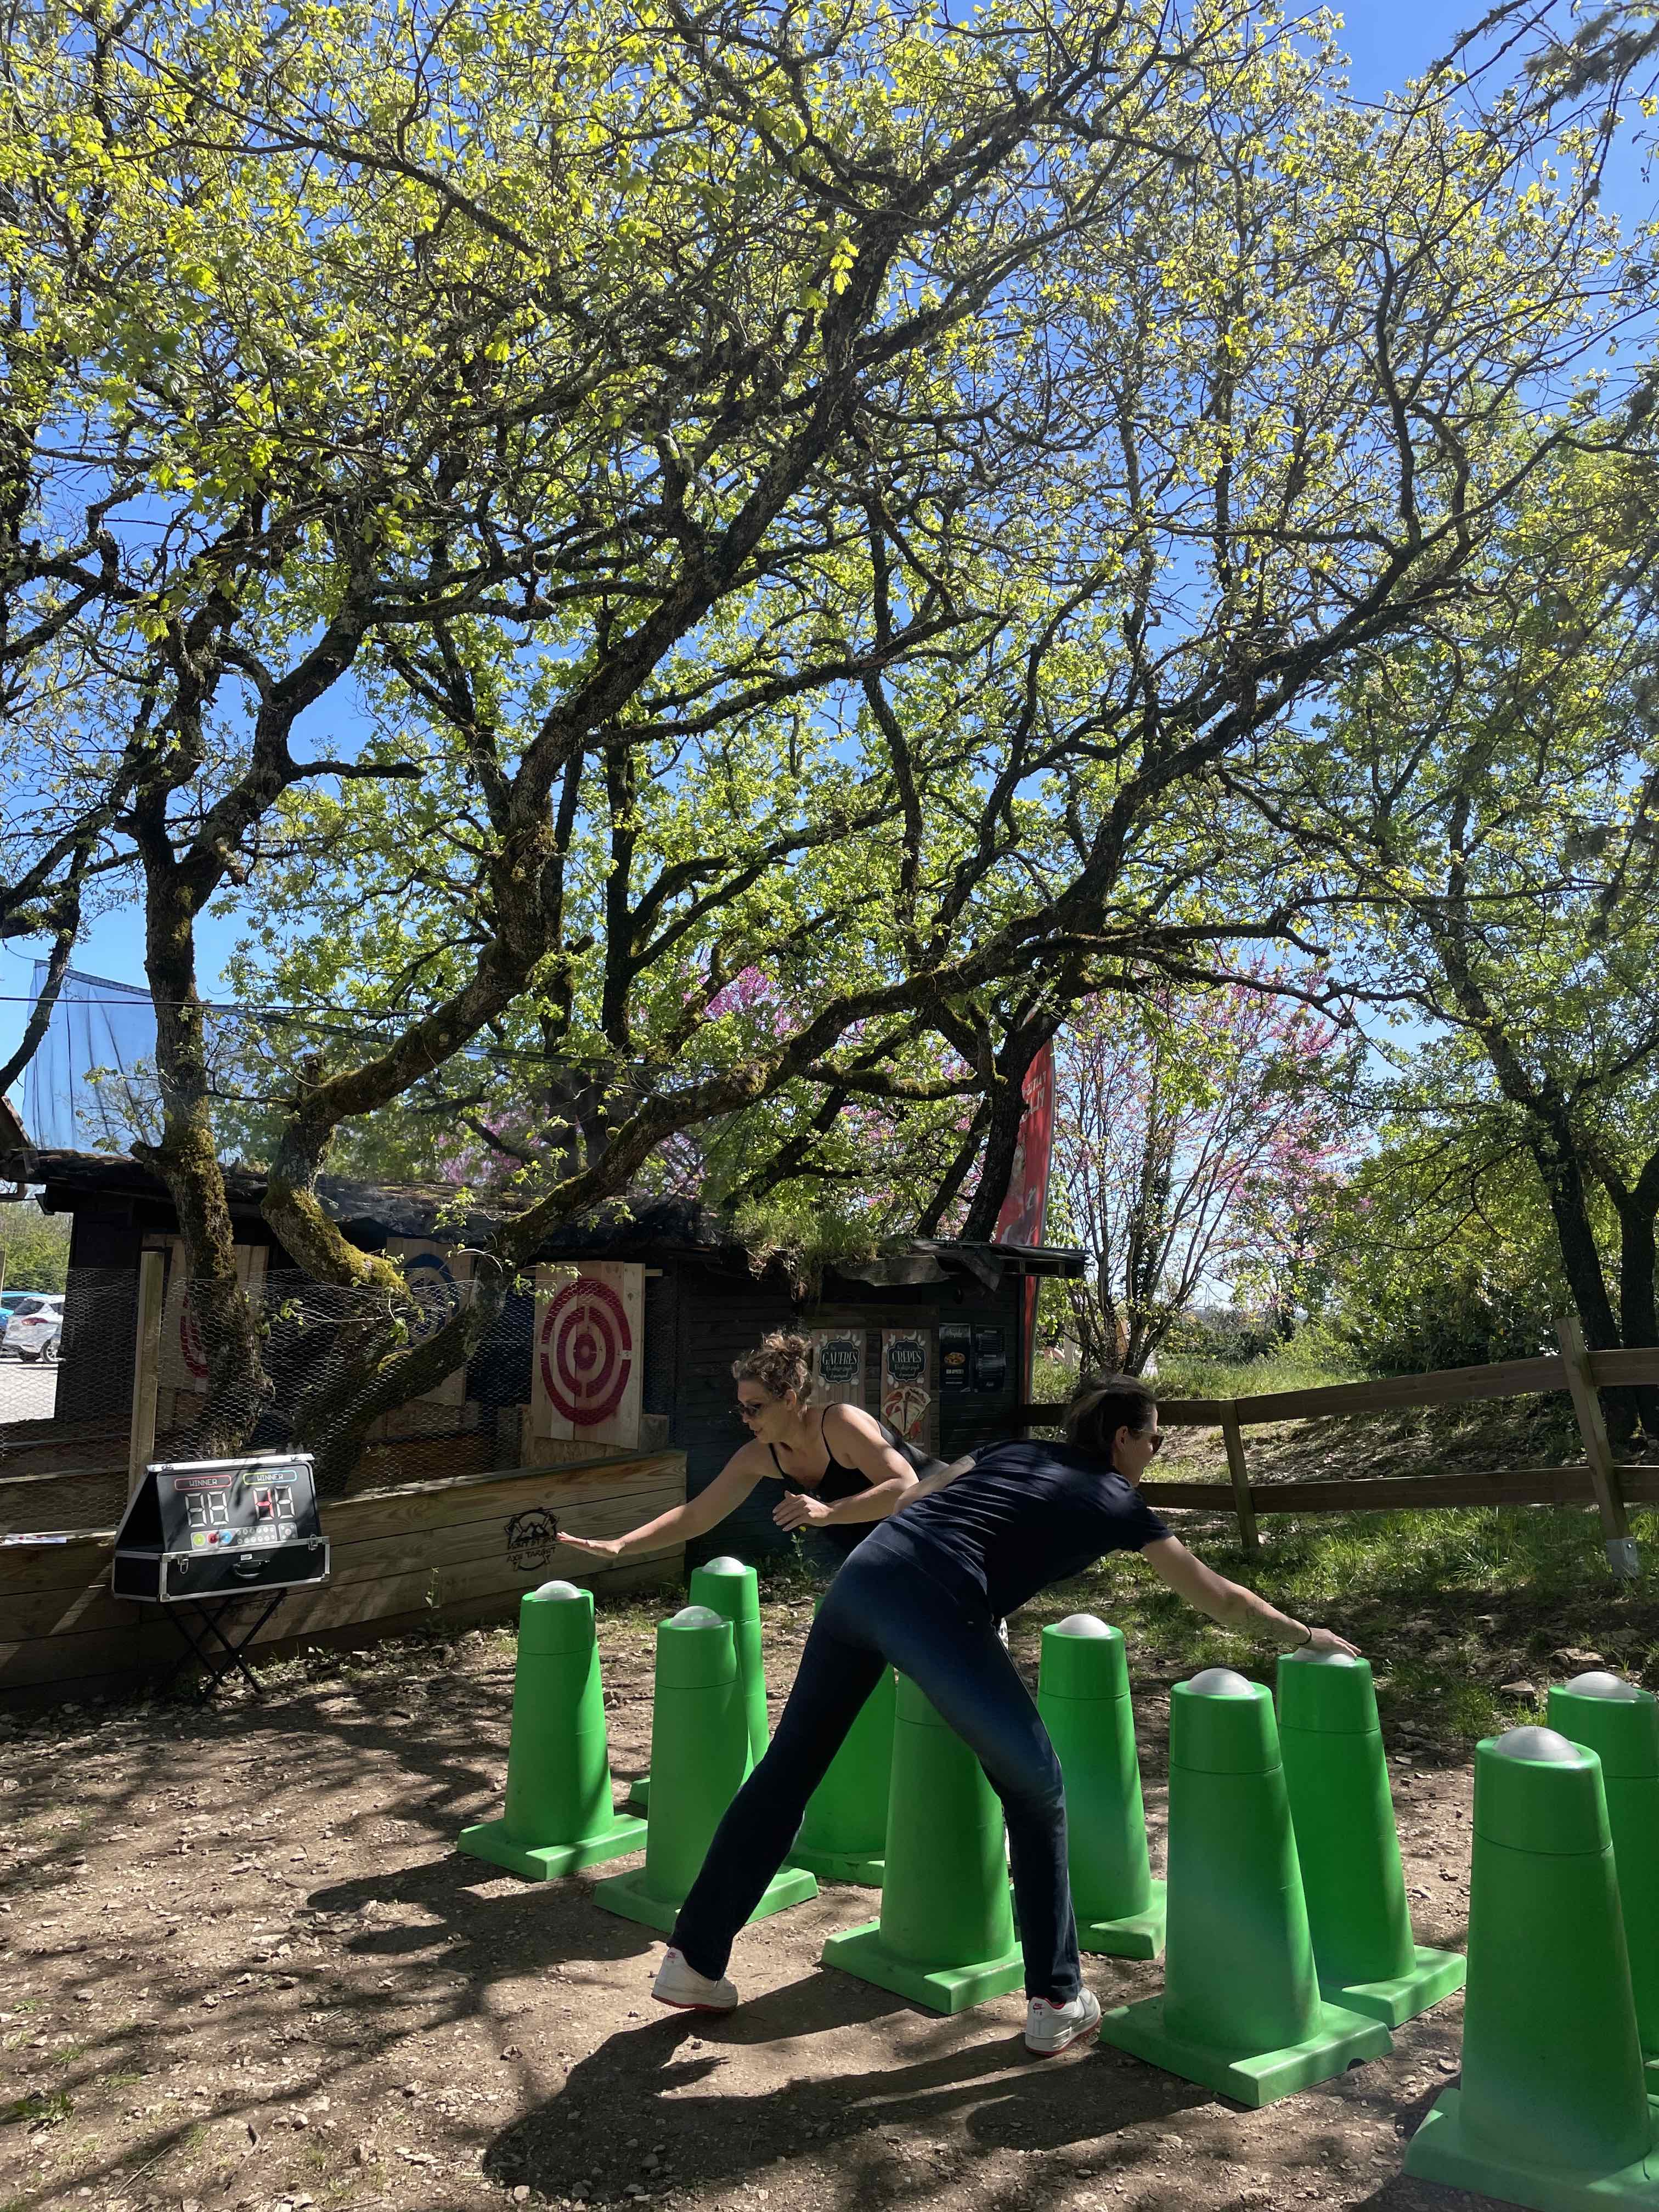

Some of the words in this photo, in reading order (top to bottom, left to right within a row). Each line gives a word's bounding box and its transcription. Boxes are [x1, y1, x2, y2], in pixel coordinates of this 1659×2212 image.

[823, 1351, 857, 1365] GAUFRES
[257, 1473, 284, 1482] WINNER
[506, 1553, 523, 1563] AXE
[525, 1547, 556, 1558] TARGET
